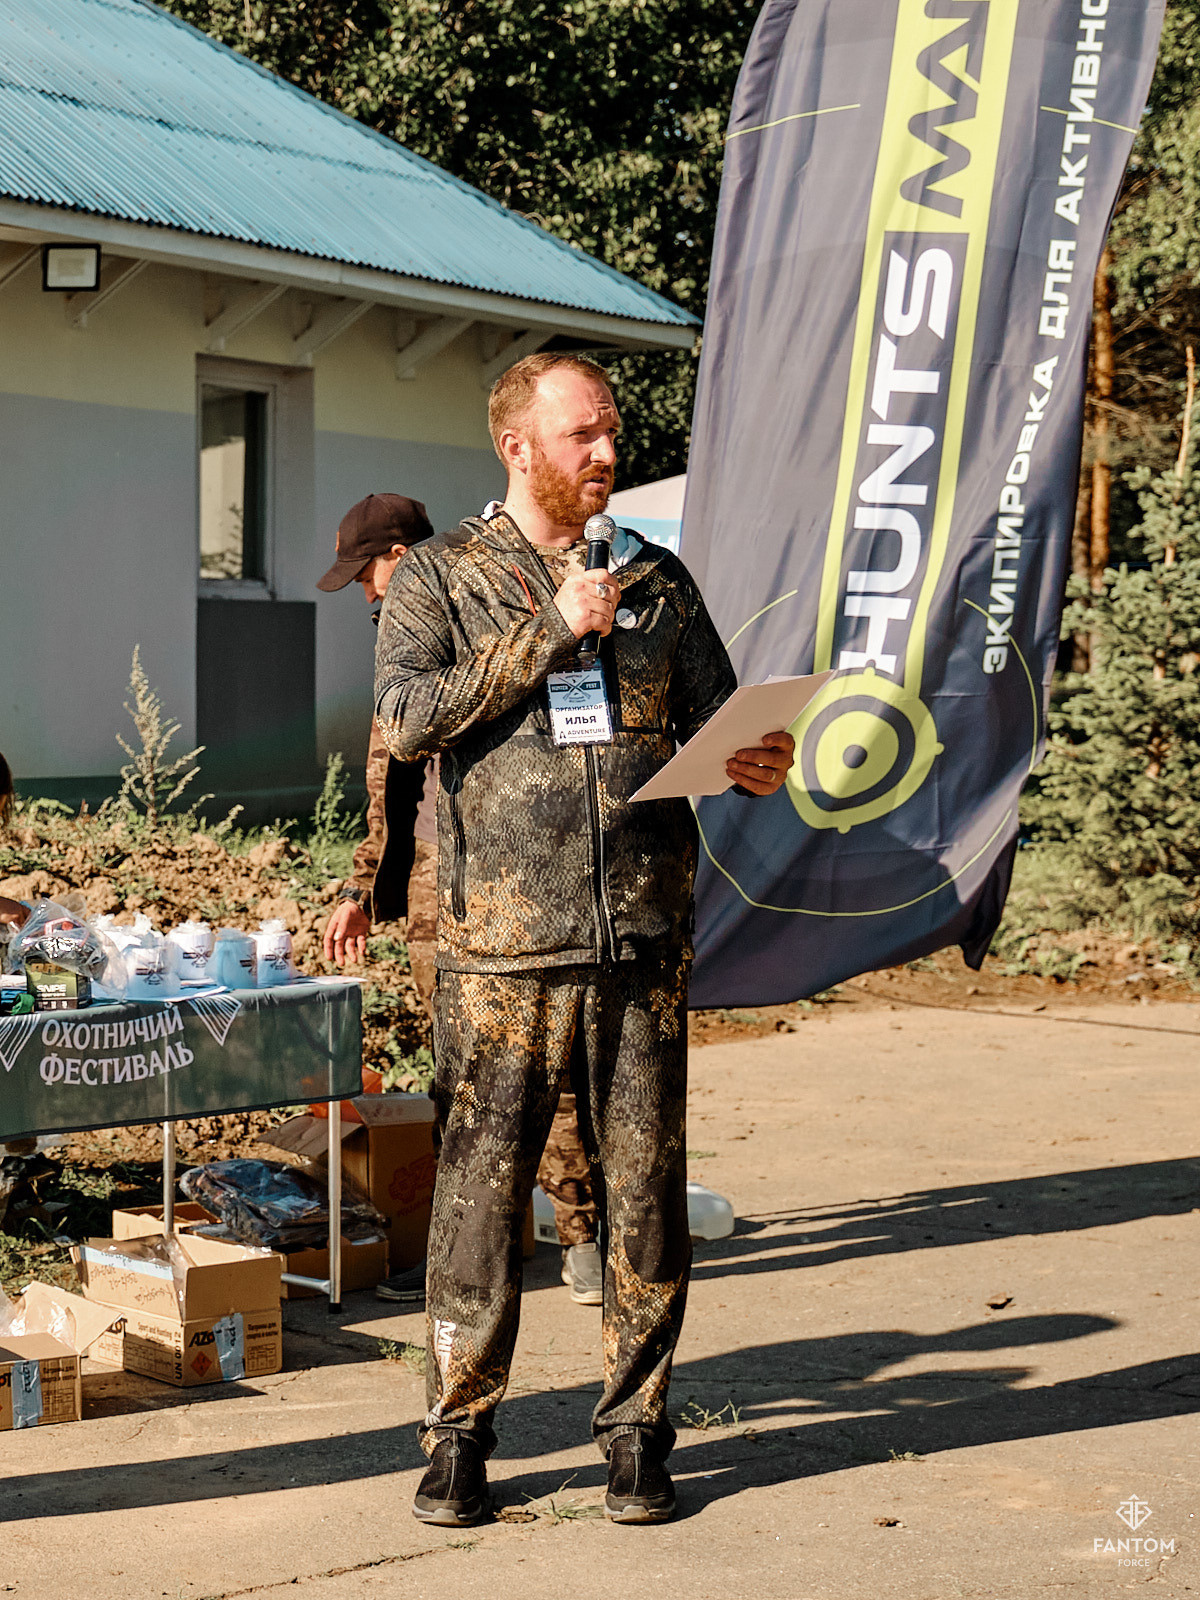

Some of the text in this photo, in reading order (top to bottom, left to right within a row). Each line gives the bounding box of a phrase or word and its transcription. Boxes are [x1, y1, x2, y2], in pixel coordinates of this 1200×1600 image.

[982, 355, 1059, 675] ЭКИПИРОВКА
[1038, 238, 1077, 340] ДЛЯ
[555, 704, 603, 713] ОРГАНИЗАТОР
[565, 715, 597, 725] ИЛЬЯ
[567, 727, 606, 736] ADVENTURE
[36, 983, 67, 993] SNIPE
[41, 1001, 185, 1050] ОХОТНИЧИЙ
[39, 1041, 195, 1086] ФЕСТИВАЛЬ
[189, 1329, 222, 1348] AZO
[174, 1331, 183, 1380] UN 0012
